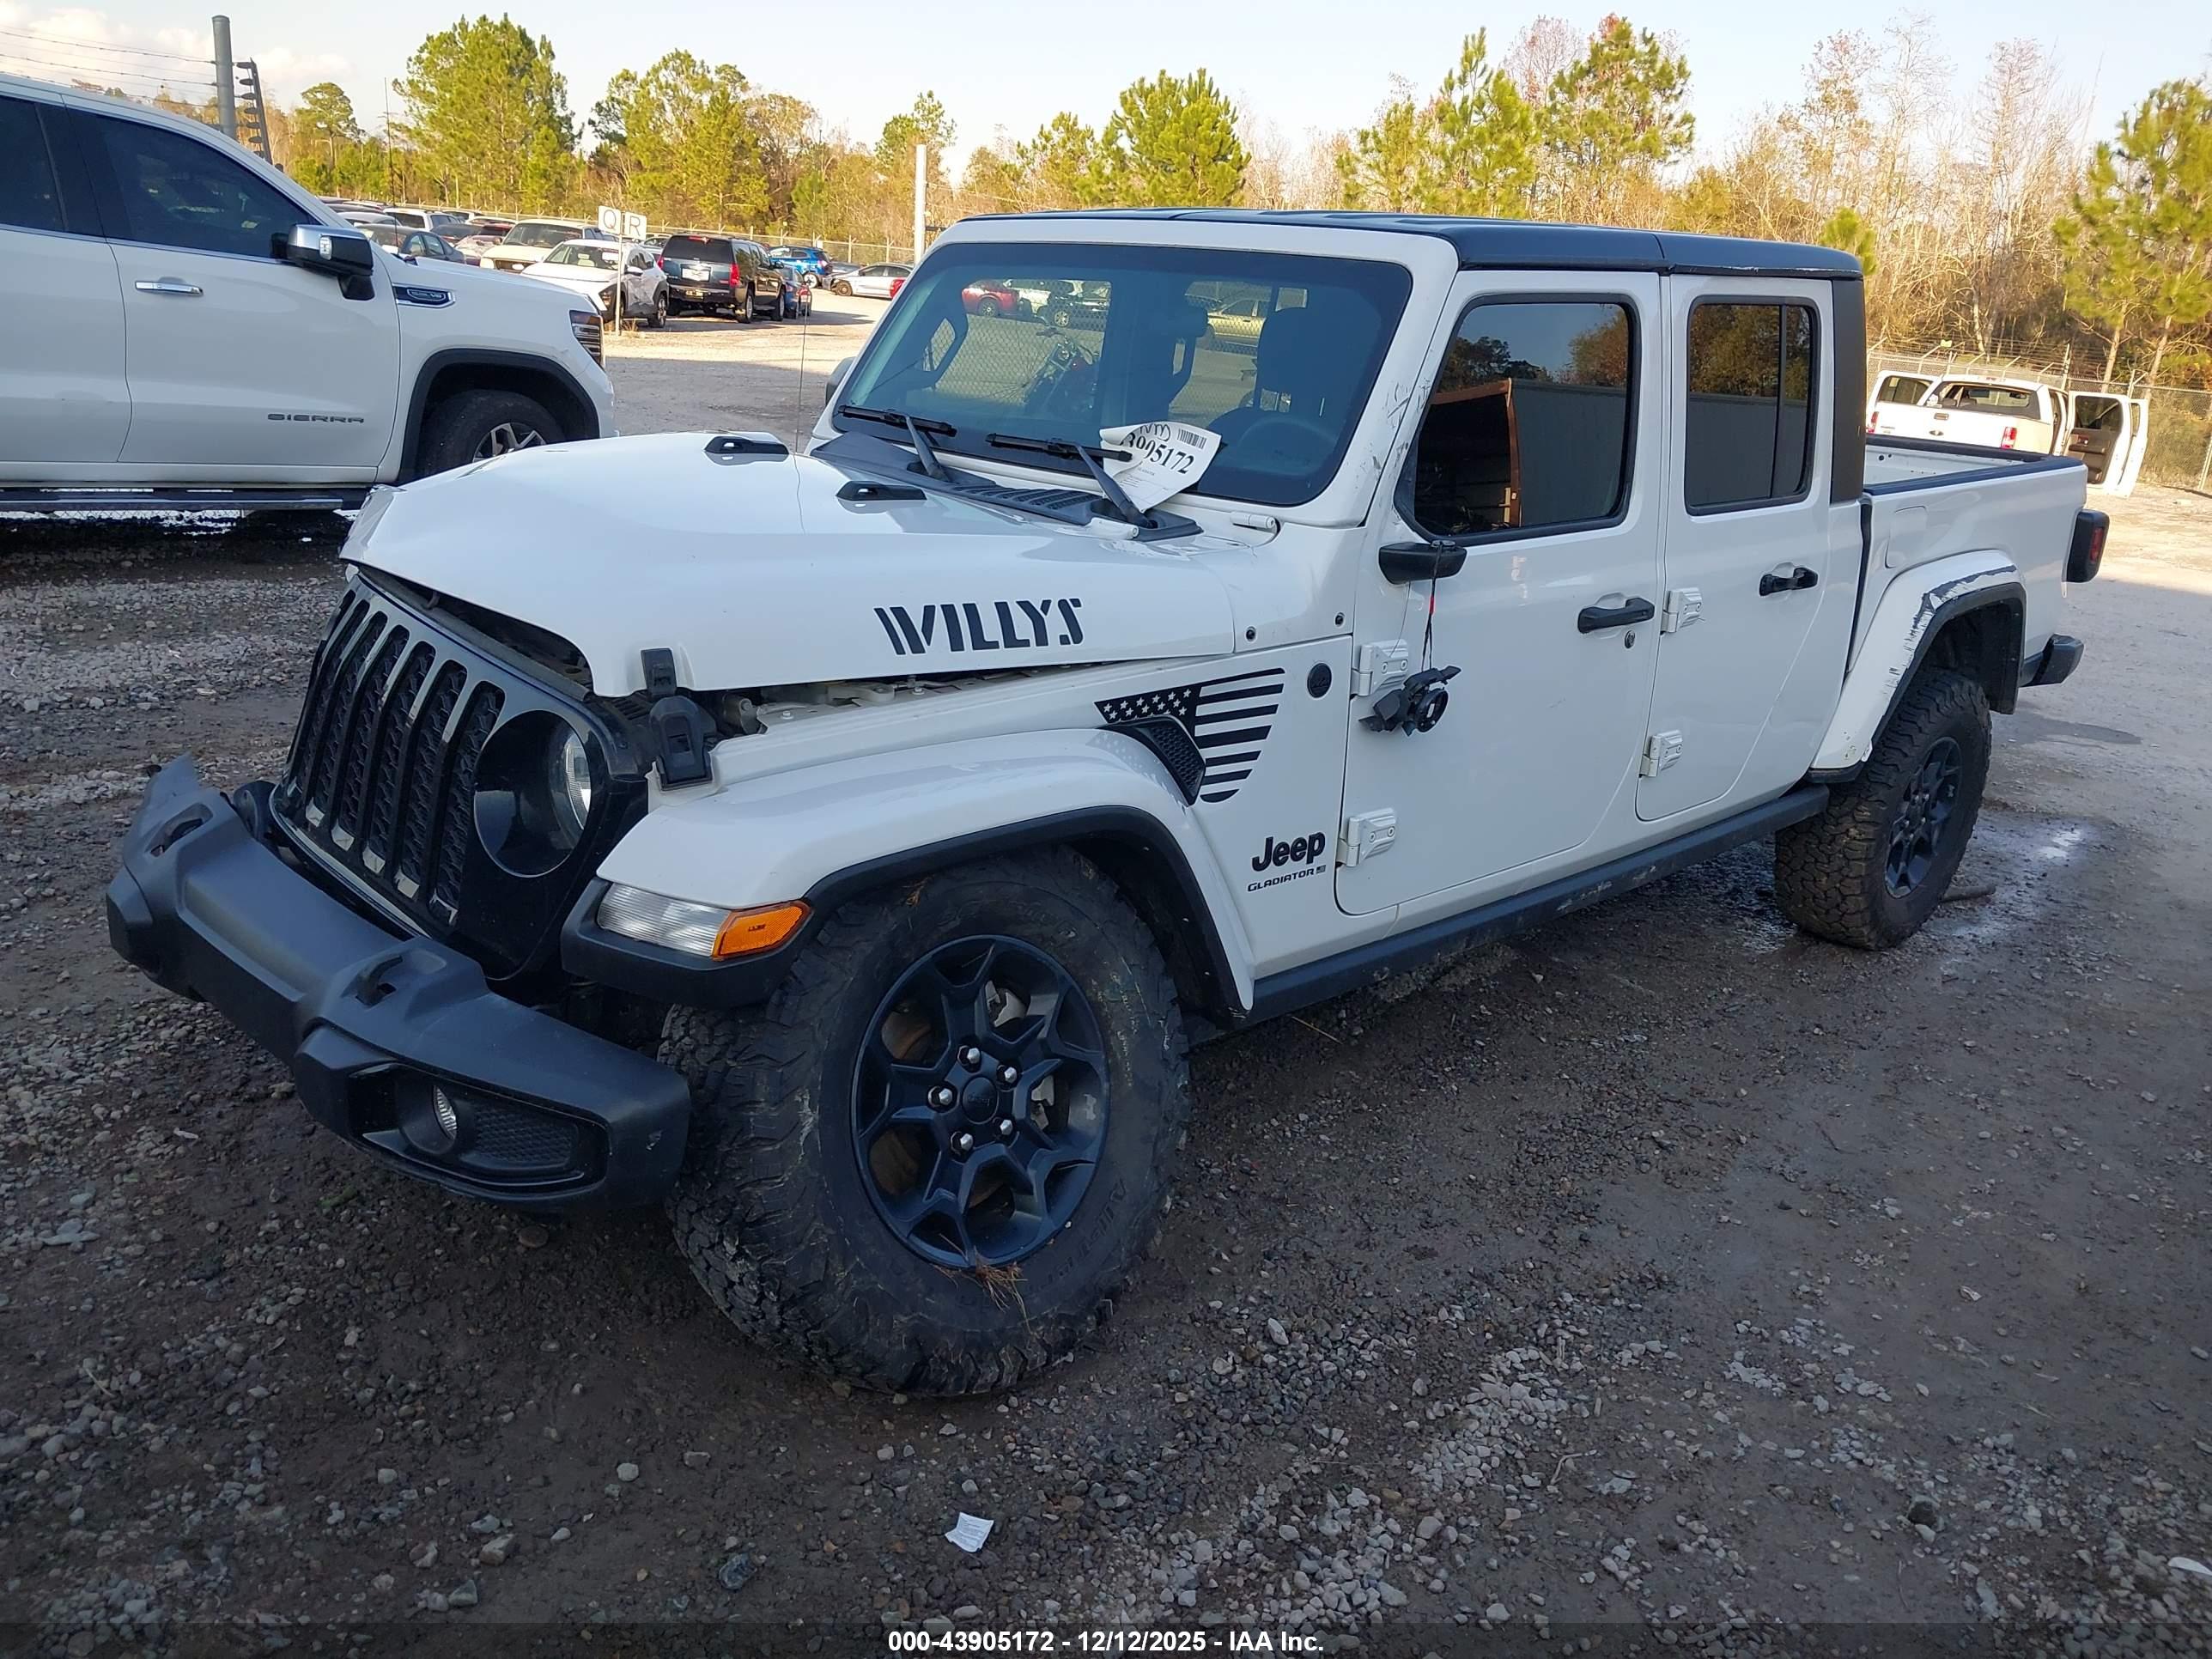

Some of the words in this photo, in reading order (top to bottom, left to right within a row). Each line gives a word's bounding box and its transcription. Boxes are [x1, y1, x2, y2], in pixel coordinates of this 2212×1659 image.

[603, 209, 617, 229] Q
[629, 216, 641, 236] R
[267, 413, 364, 423] SIERRA
[873, 598, 1084, 655] WILLYS
[1251, 831, 1326, 872] Jeep
[1247, 866, 1315, 892] GLADIATOR
